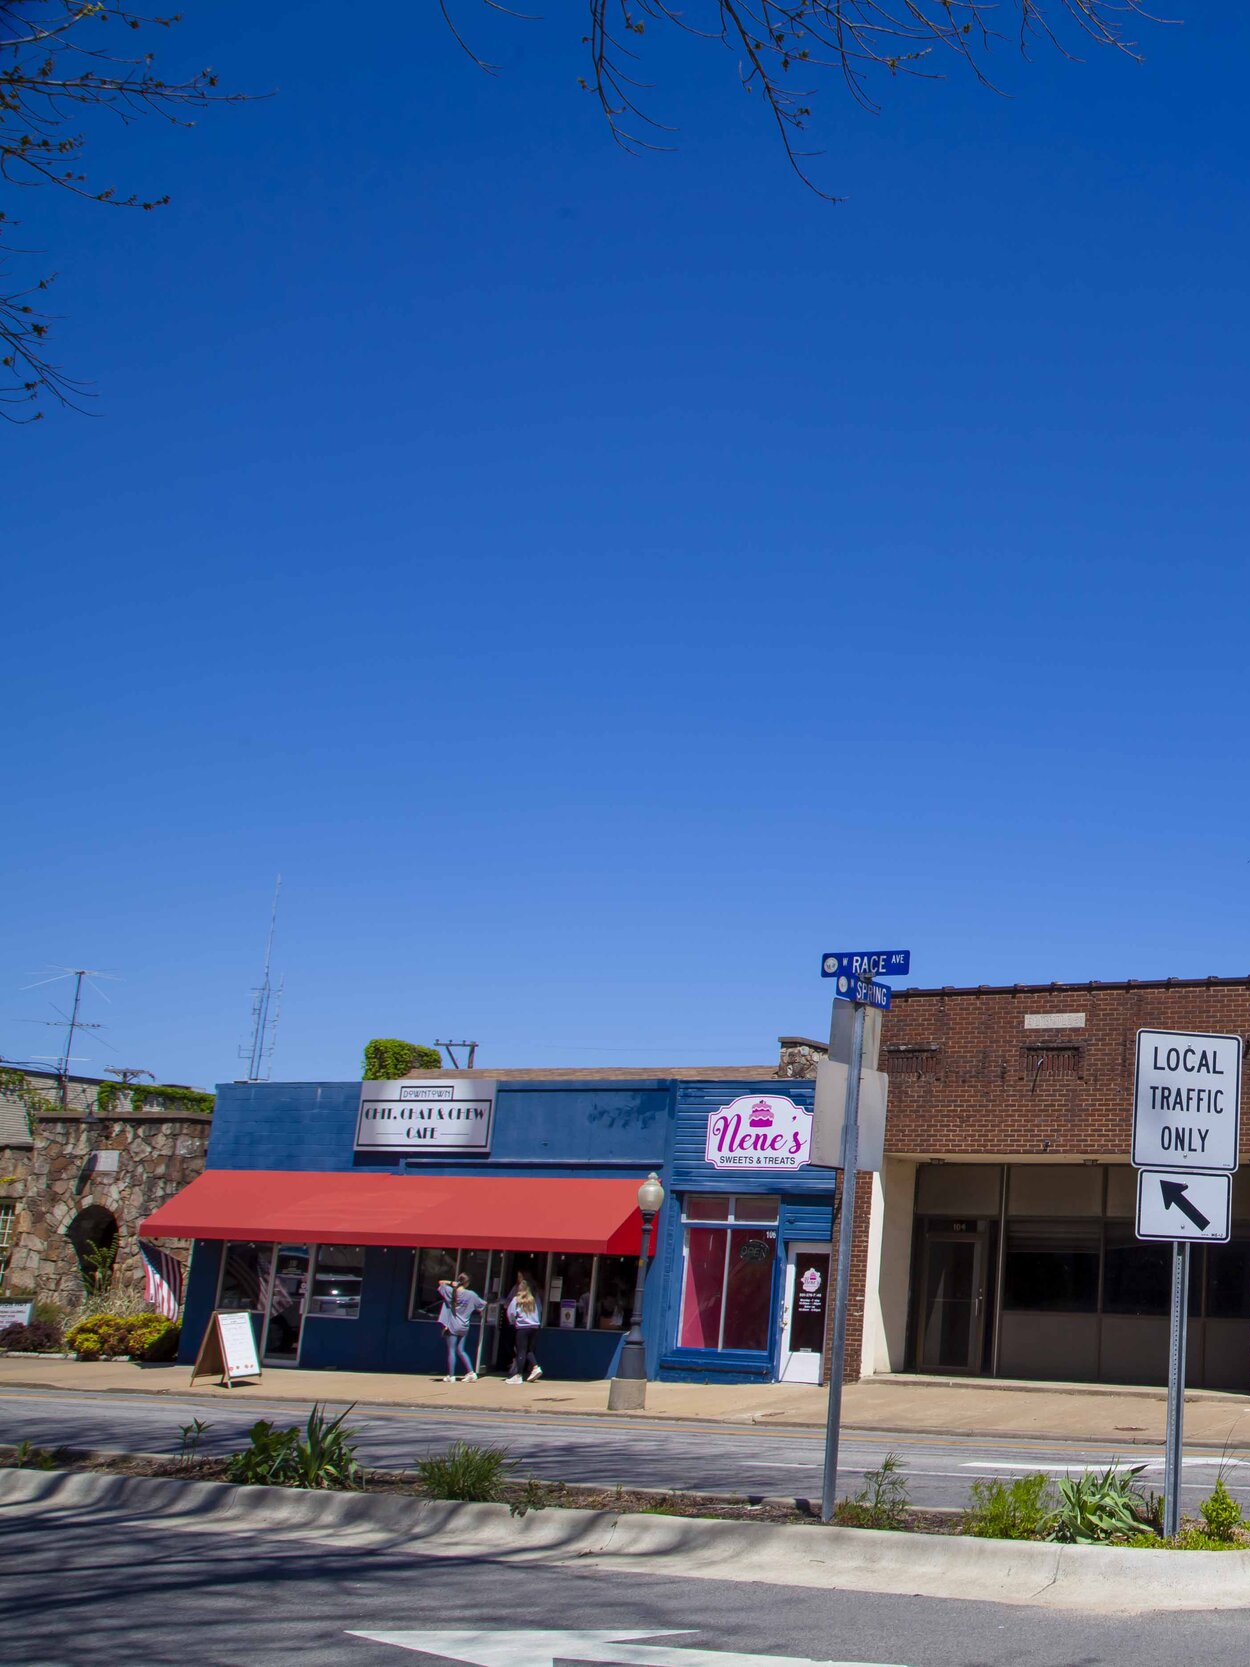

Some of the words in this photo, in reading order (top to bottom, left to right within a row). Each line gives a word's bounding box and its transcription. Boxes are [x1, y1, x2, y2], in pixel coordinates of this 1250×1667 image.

[842, 957, 849, 967] W
[852, 955, 887, 973] RACE
[891, 954, 905, 964] AVE
[856, 981, 887, 1005] SPRING
[1153, 1046, 1224, 1075] LOCAL
[403, 1089, 451, 1099] DOWNTOWN
[1149, 1085, 1224, 1114] TRAFFIC
[400, 1107, 434, 1120] CHAT
[437, 1108, 445, 1120] &
[448, 1108, 486, 1120] CHEW
[406, 1127, 438, 1139] CAFE
[712, 1113, 808, 1155] Nene's
[1160, 1125, 1209, 1153] ONLY
[719, 1155, 754, 1165] SWEETS
[754, 1157, 762, 1165] &
[763, 1156, 796, 1165] TREATS
